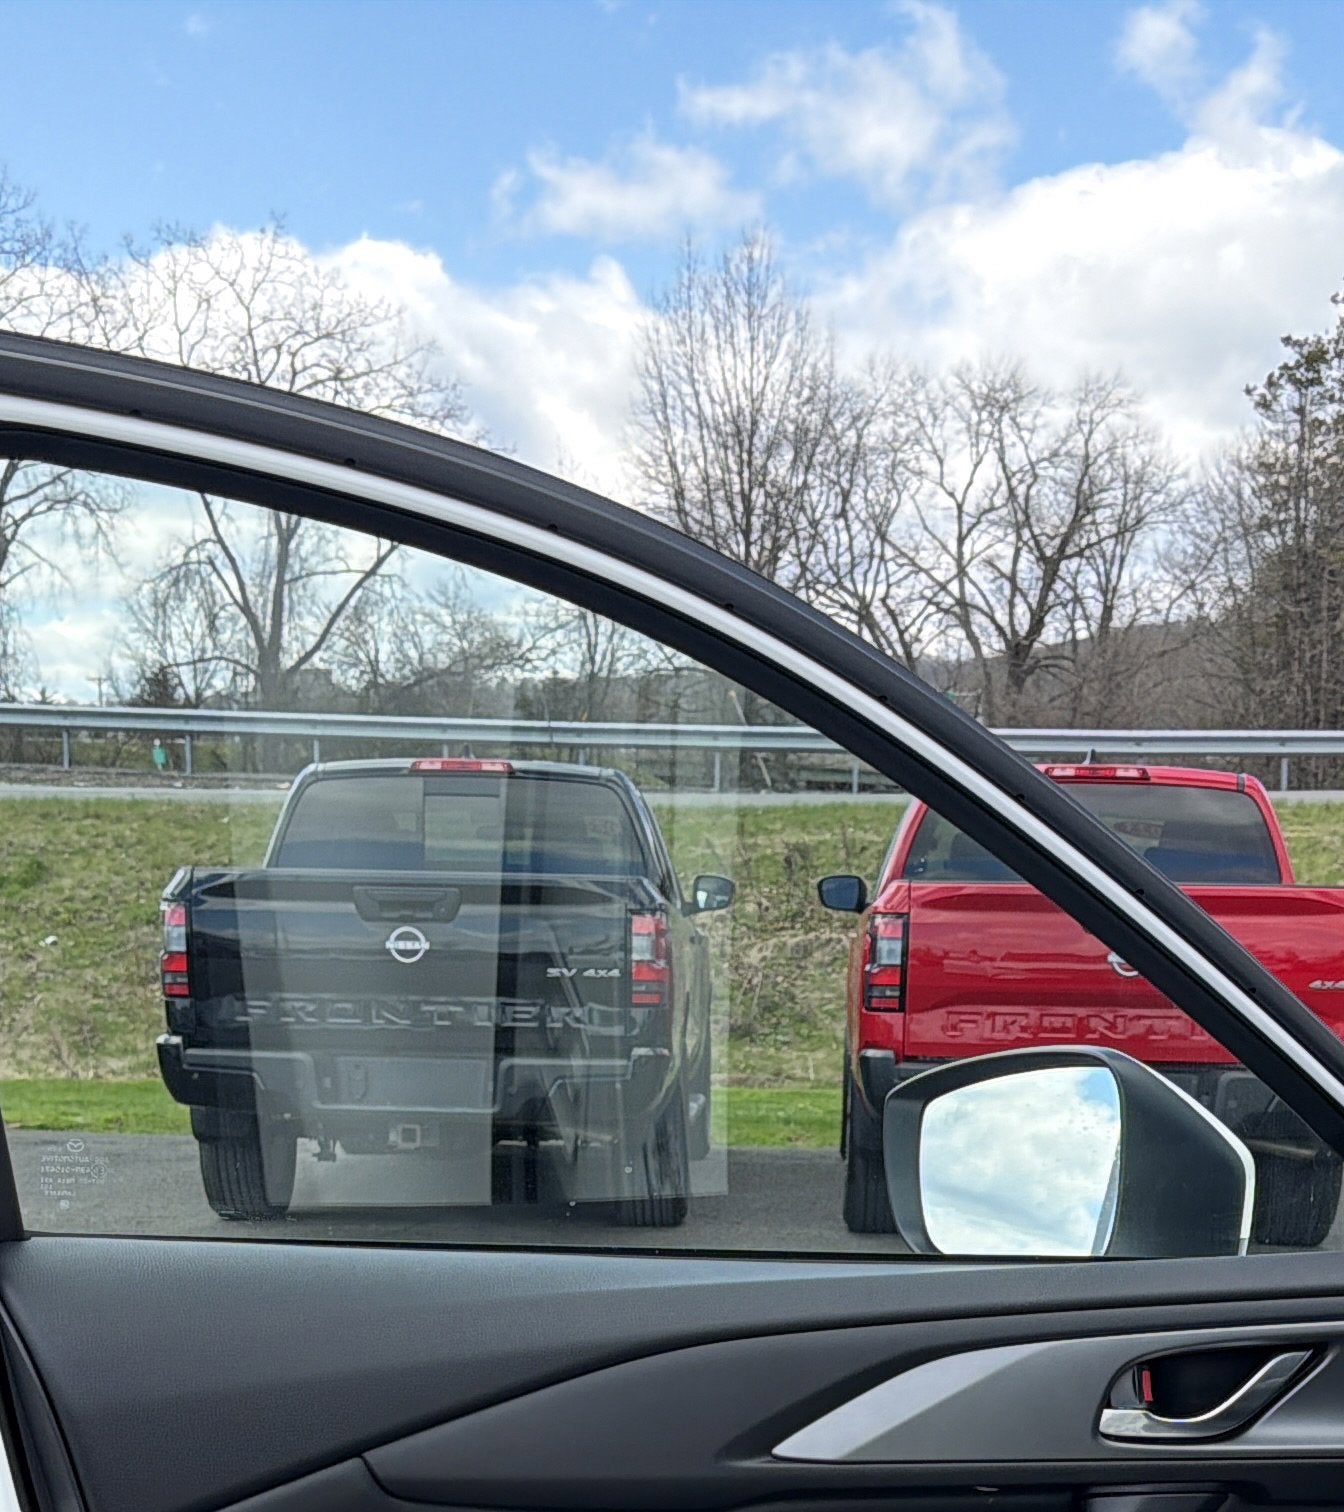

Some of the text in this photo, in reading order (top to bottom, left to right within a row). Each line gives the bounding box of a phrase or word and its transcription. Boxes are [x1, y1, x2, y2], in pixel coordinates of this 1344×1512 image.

[546, 967, 578, 978] SV
[234, 1000, 589, 1028] FRONTIER
[943, 1010, 1213, 1041] FRONTI
